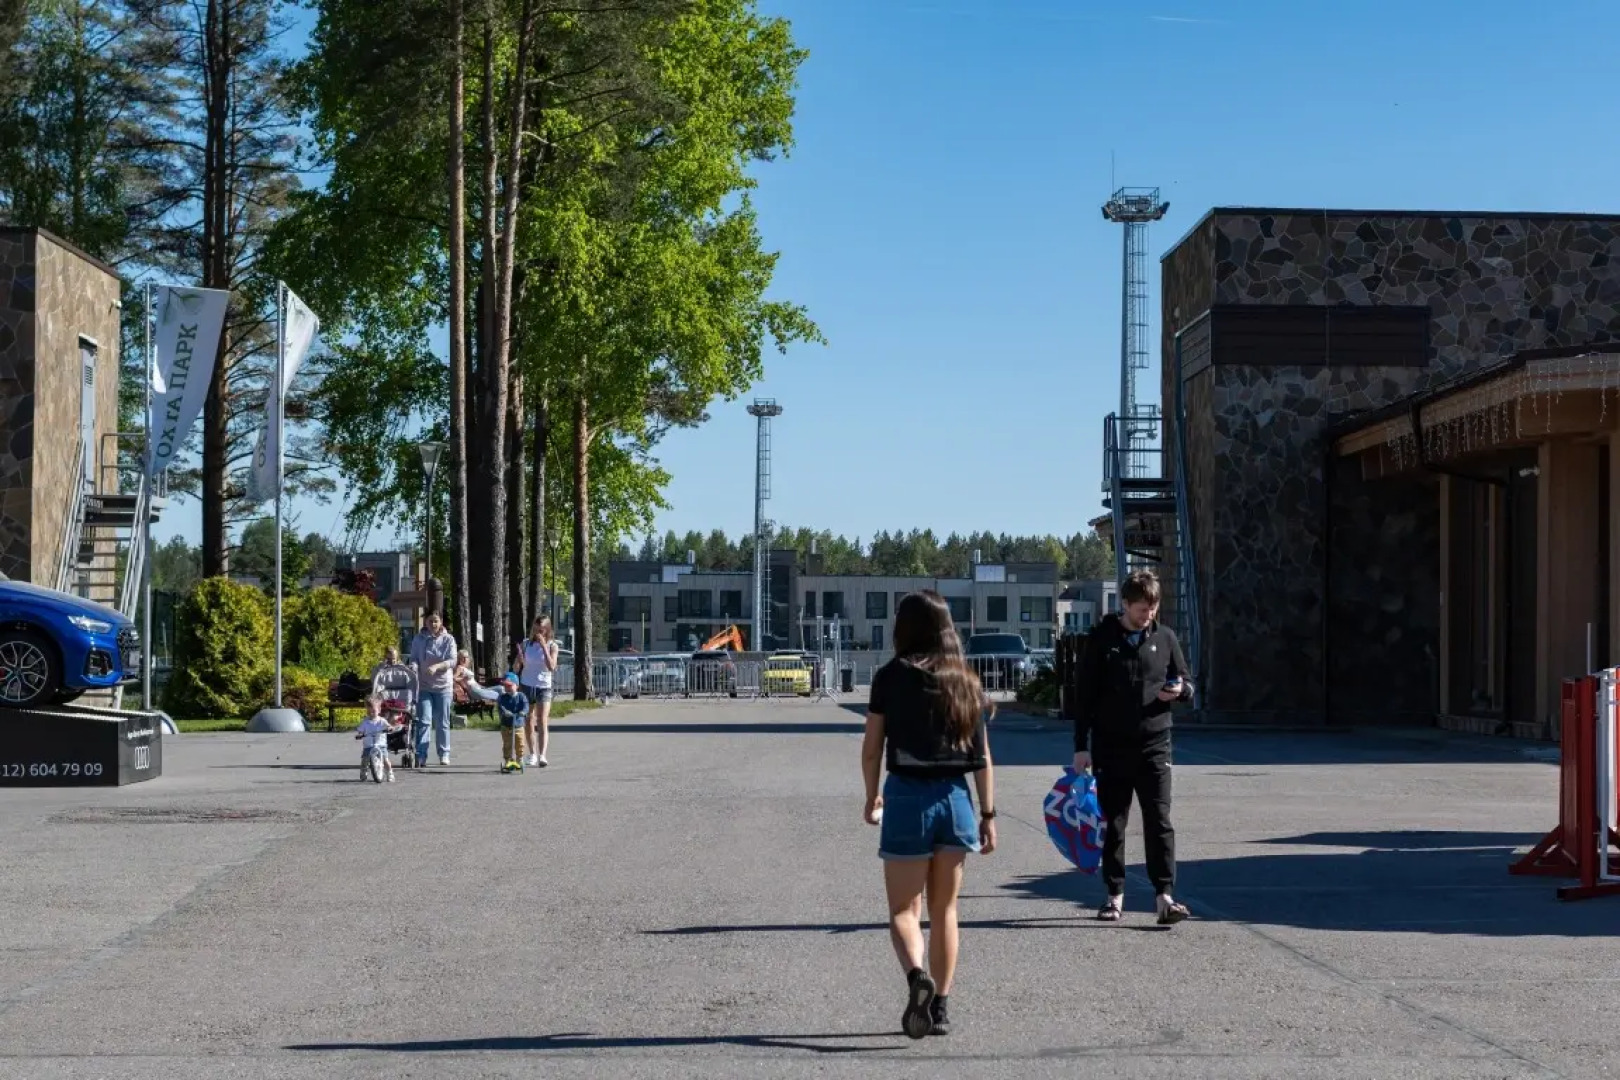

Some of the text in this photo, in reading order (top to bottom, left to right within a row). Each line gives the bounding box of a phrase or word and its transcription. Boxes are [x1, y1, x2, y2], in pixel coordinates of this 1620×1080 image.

[168, 323, 198, 390] ПАРК
[0, 763, 103, 778] 12) 604 79 09
